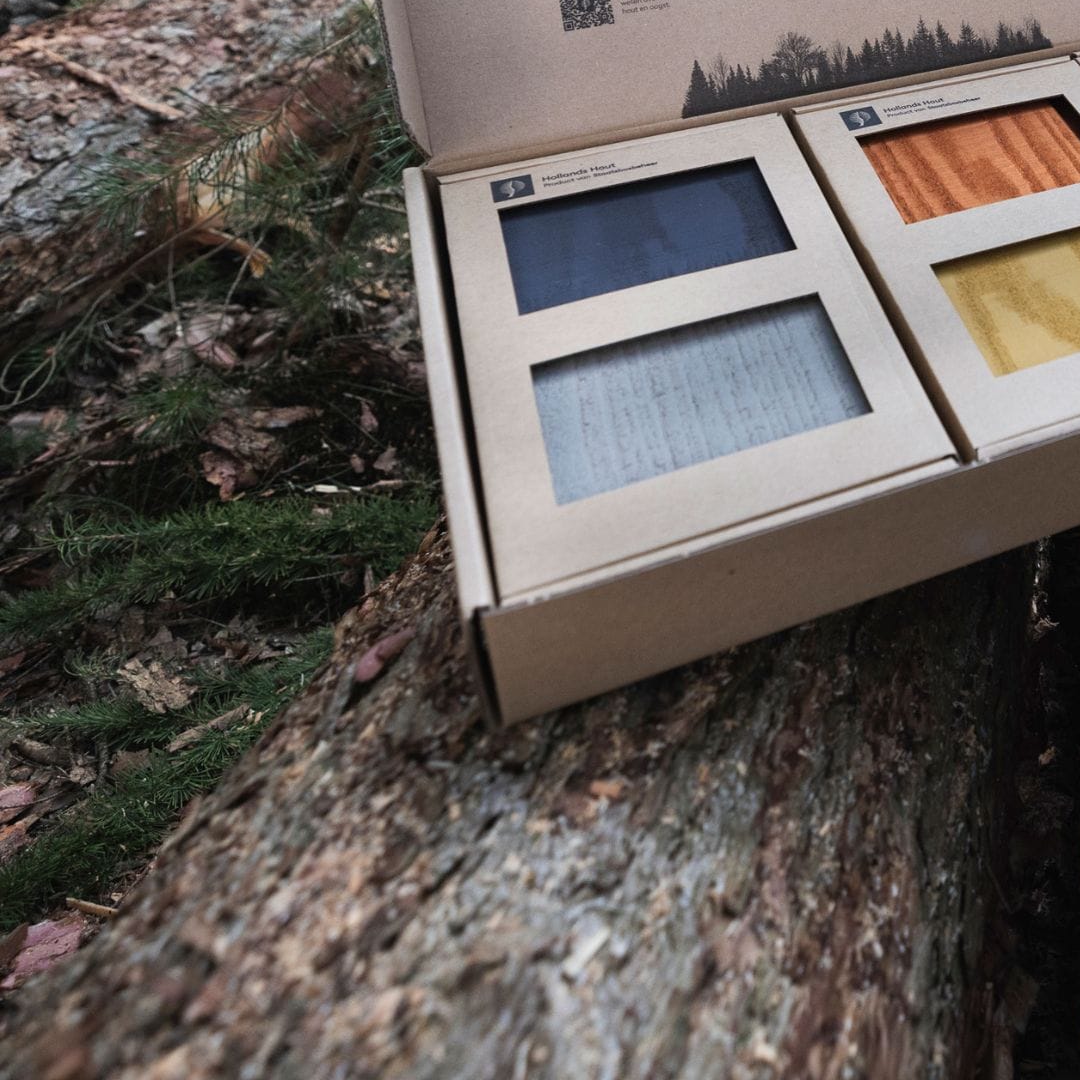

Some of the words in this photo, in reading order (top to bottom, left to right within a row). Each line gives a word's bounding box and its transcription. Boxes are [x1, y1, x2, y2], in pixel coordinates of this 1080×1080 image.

[883, 102, 922, 114] Hollands
[923, 97, 945, 106] Hout
[541, 168, 588, 182] Hollands
[590, 162, 617, 173] Hout
